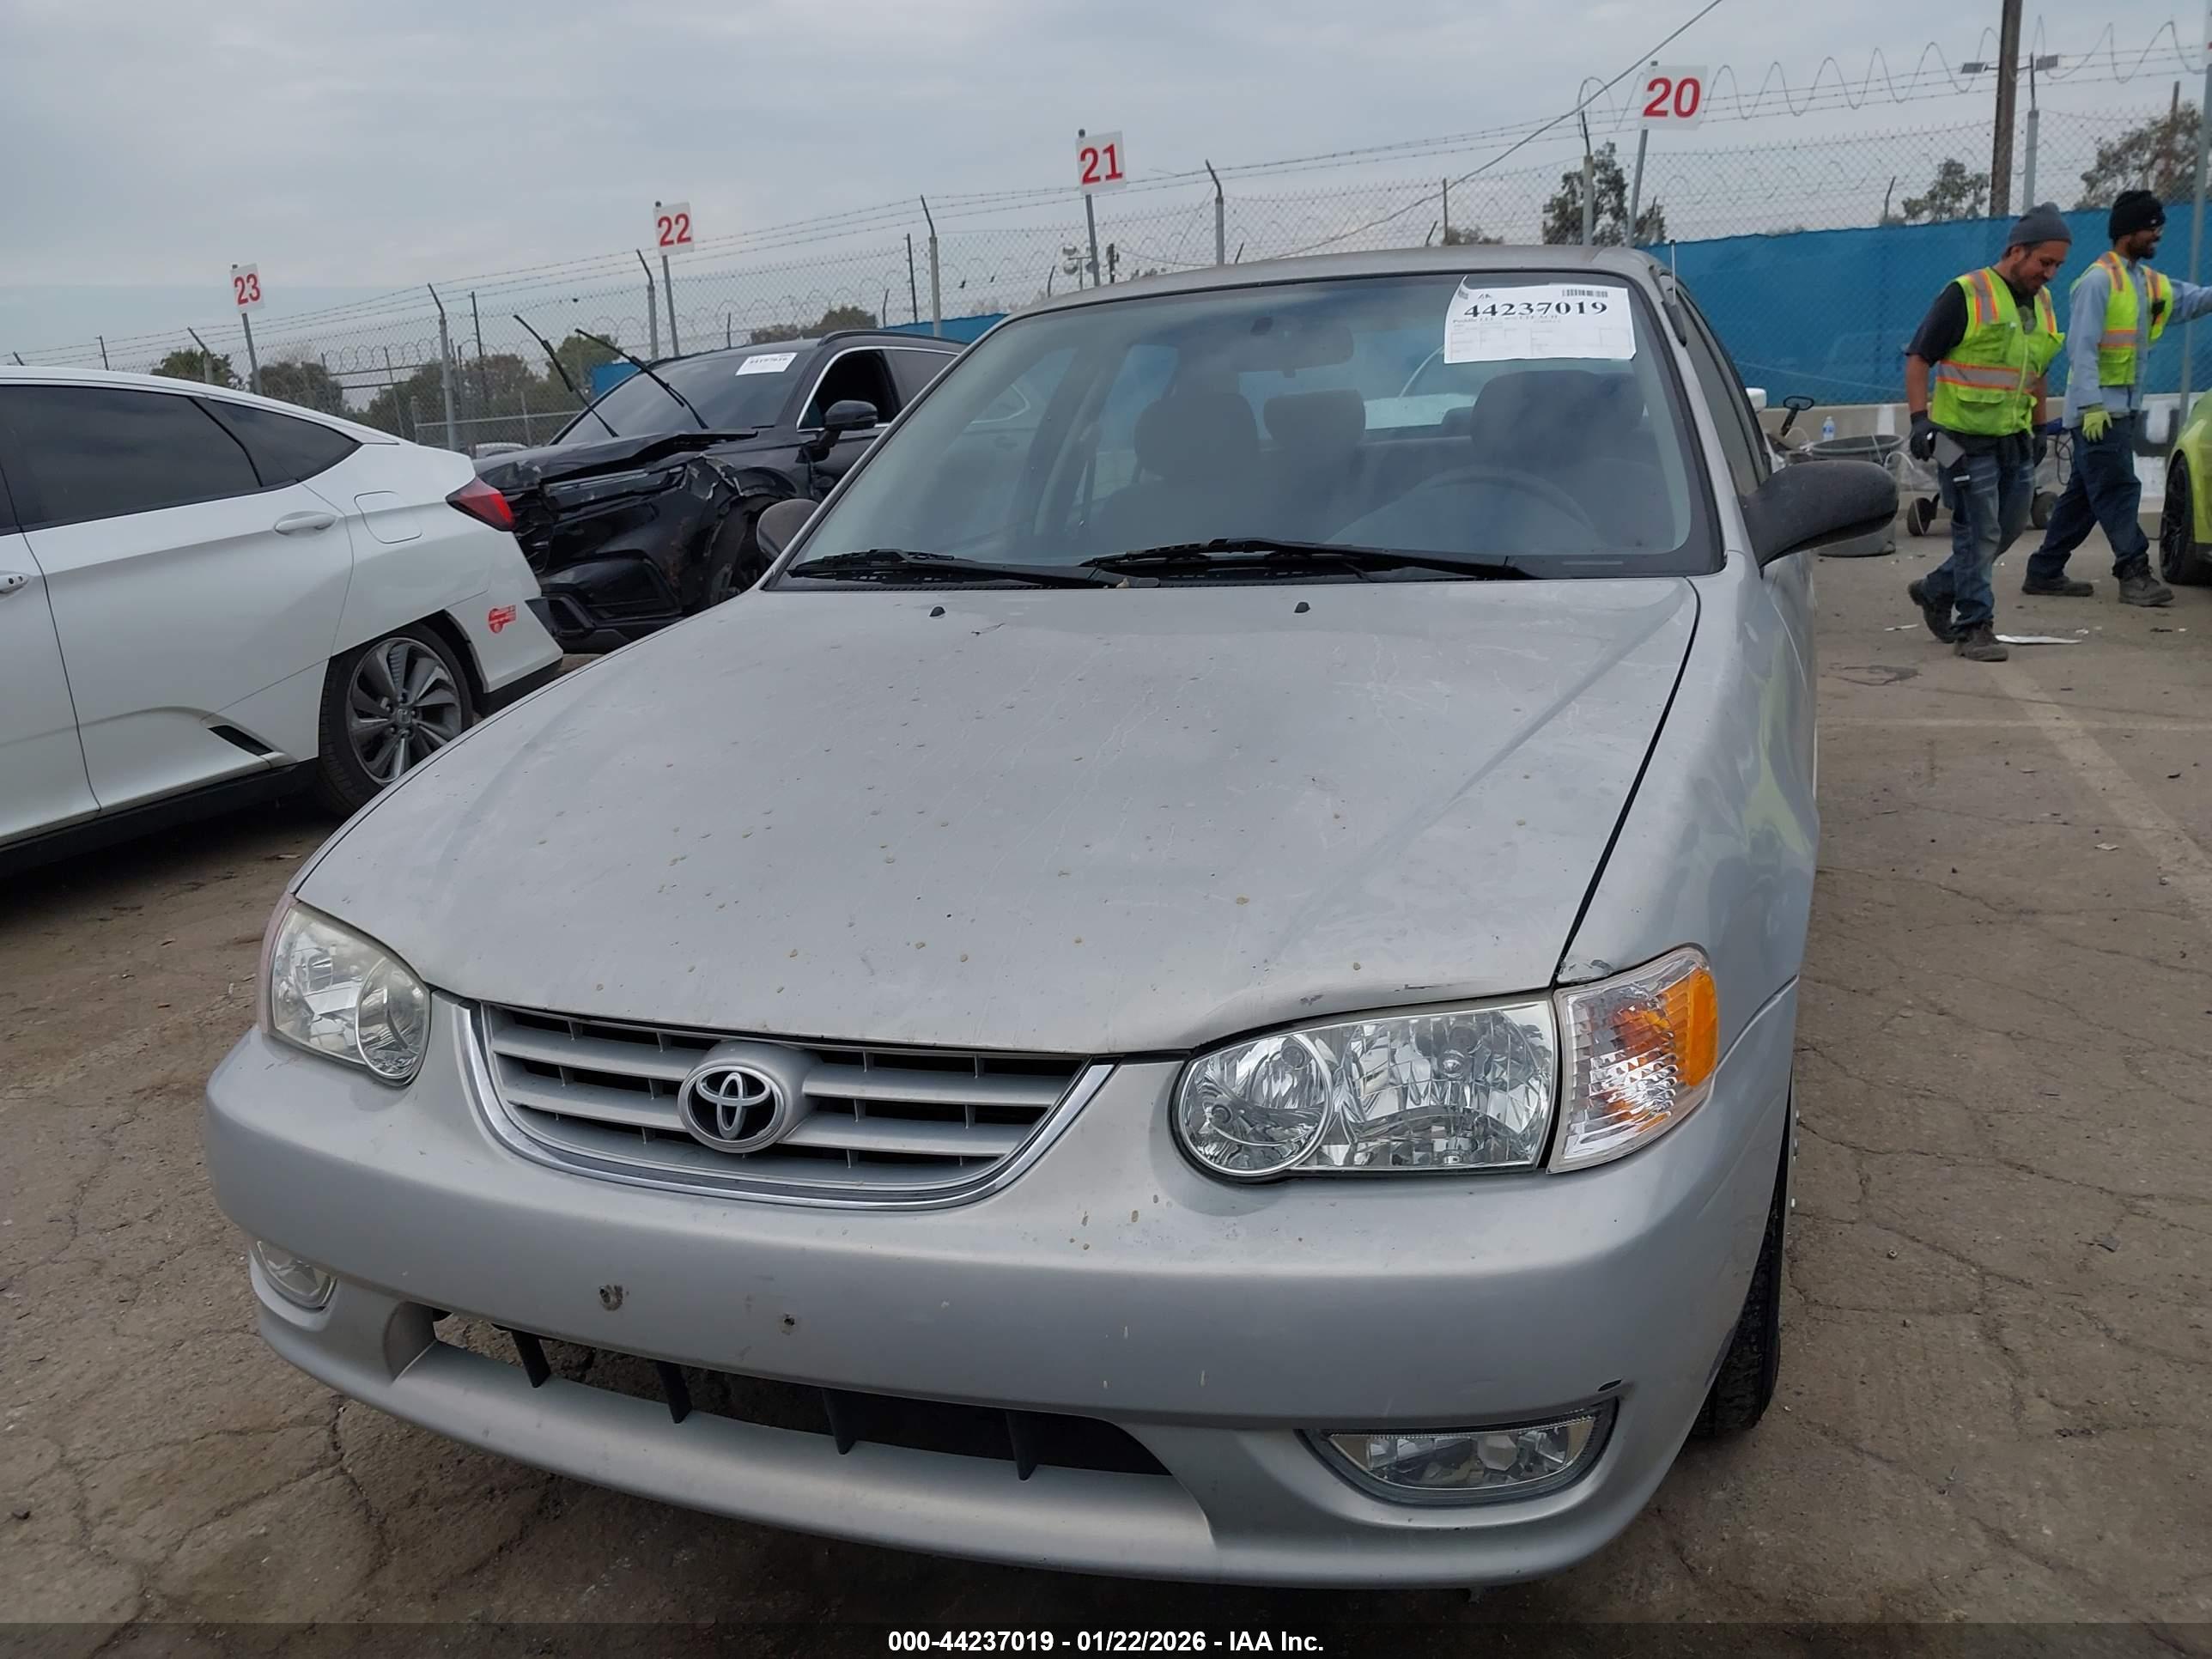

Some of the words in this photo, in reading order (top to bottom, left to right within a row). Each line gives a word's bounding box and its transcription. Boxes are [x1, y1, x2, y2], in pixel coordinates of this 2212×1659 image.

[1643, 77, 1701, 118] 20
[1079, 143, 1123, 185] 21
[659, 213, 691, 247] 22
[234, 274, 261, 305] 23
[1464, 301, 1607, 318] 44237019
